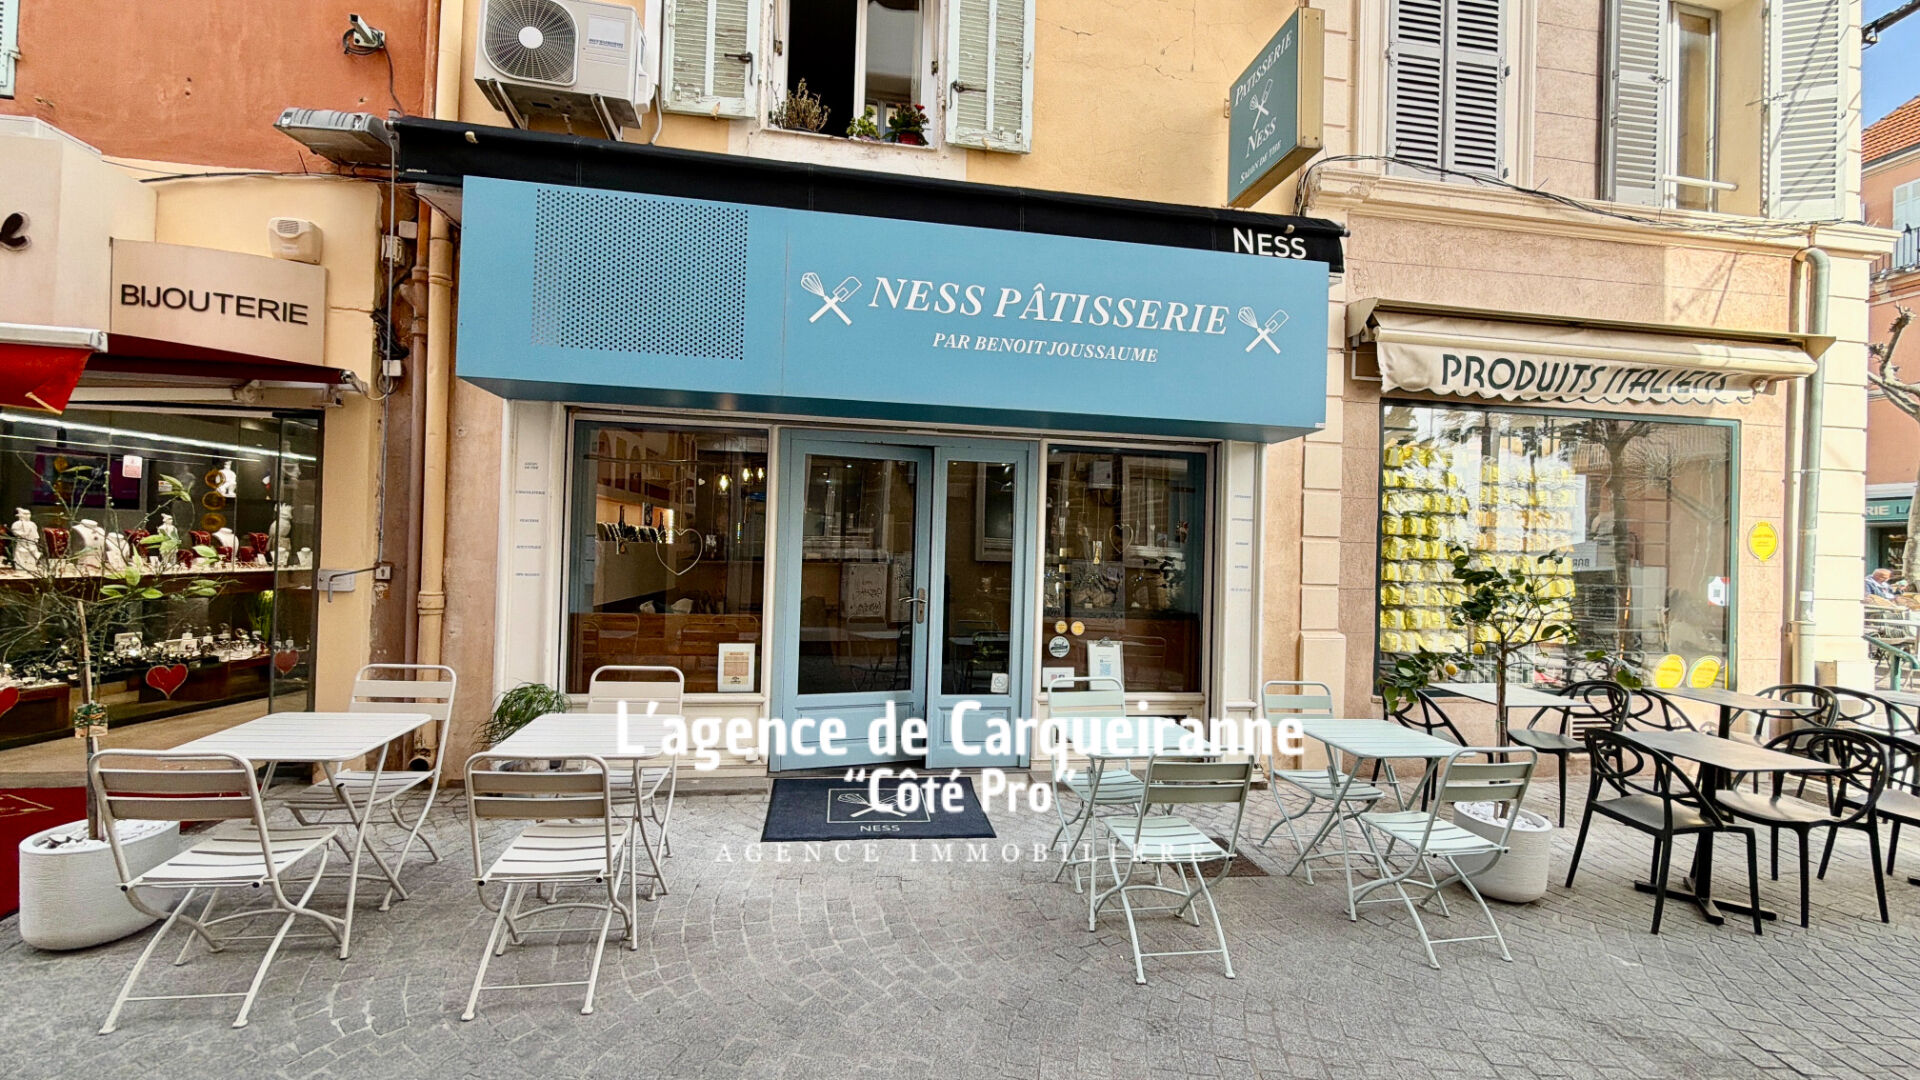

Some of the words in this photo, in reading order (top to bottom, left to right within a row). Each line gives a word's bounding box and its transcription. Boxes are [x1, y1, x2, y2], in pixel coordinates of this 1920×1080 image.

[1245, 117, 1277, 159] NESS
[1233, 227, 1307, 259] NESS
[121, 284, 309, 325] BIJOUTERIE
[868, 276, 984, 316] NESS
[993, 283, 1230, 335] PÂTISSERIE
[932, 332, 971, 349] PAR
[974, 336, 1048, 355] BENOIT
[1047, 341, 1159, 363] JOUSSAUME
[1441, 354, 1607, 392] PRODUITS
[860, 824, 900, 832] NESS
